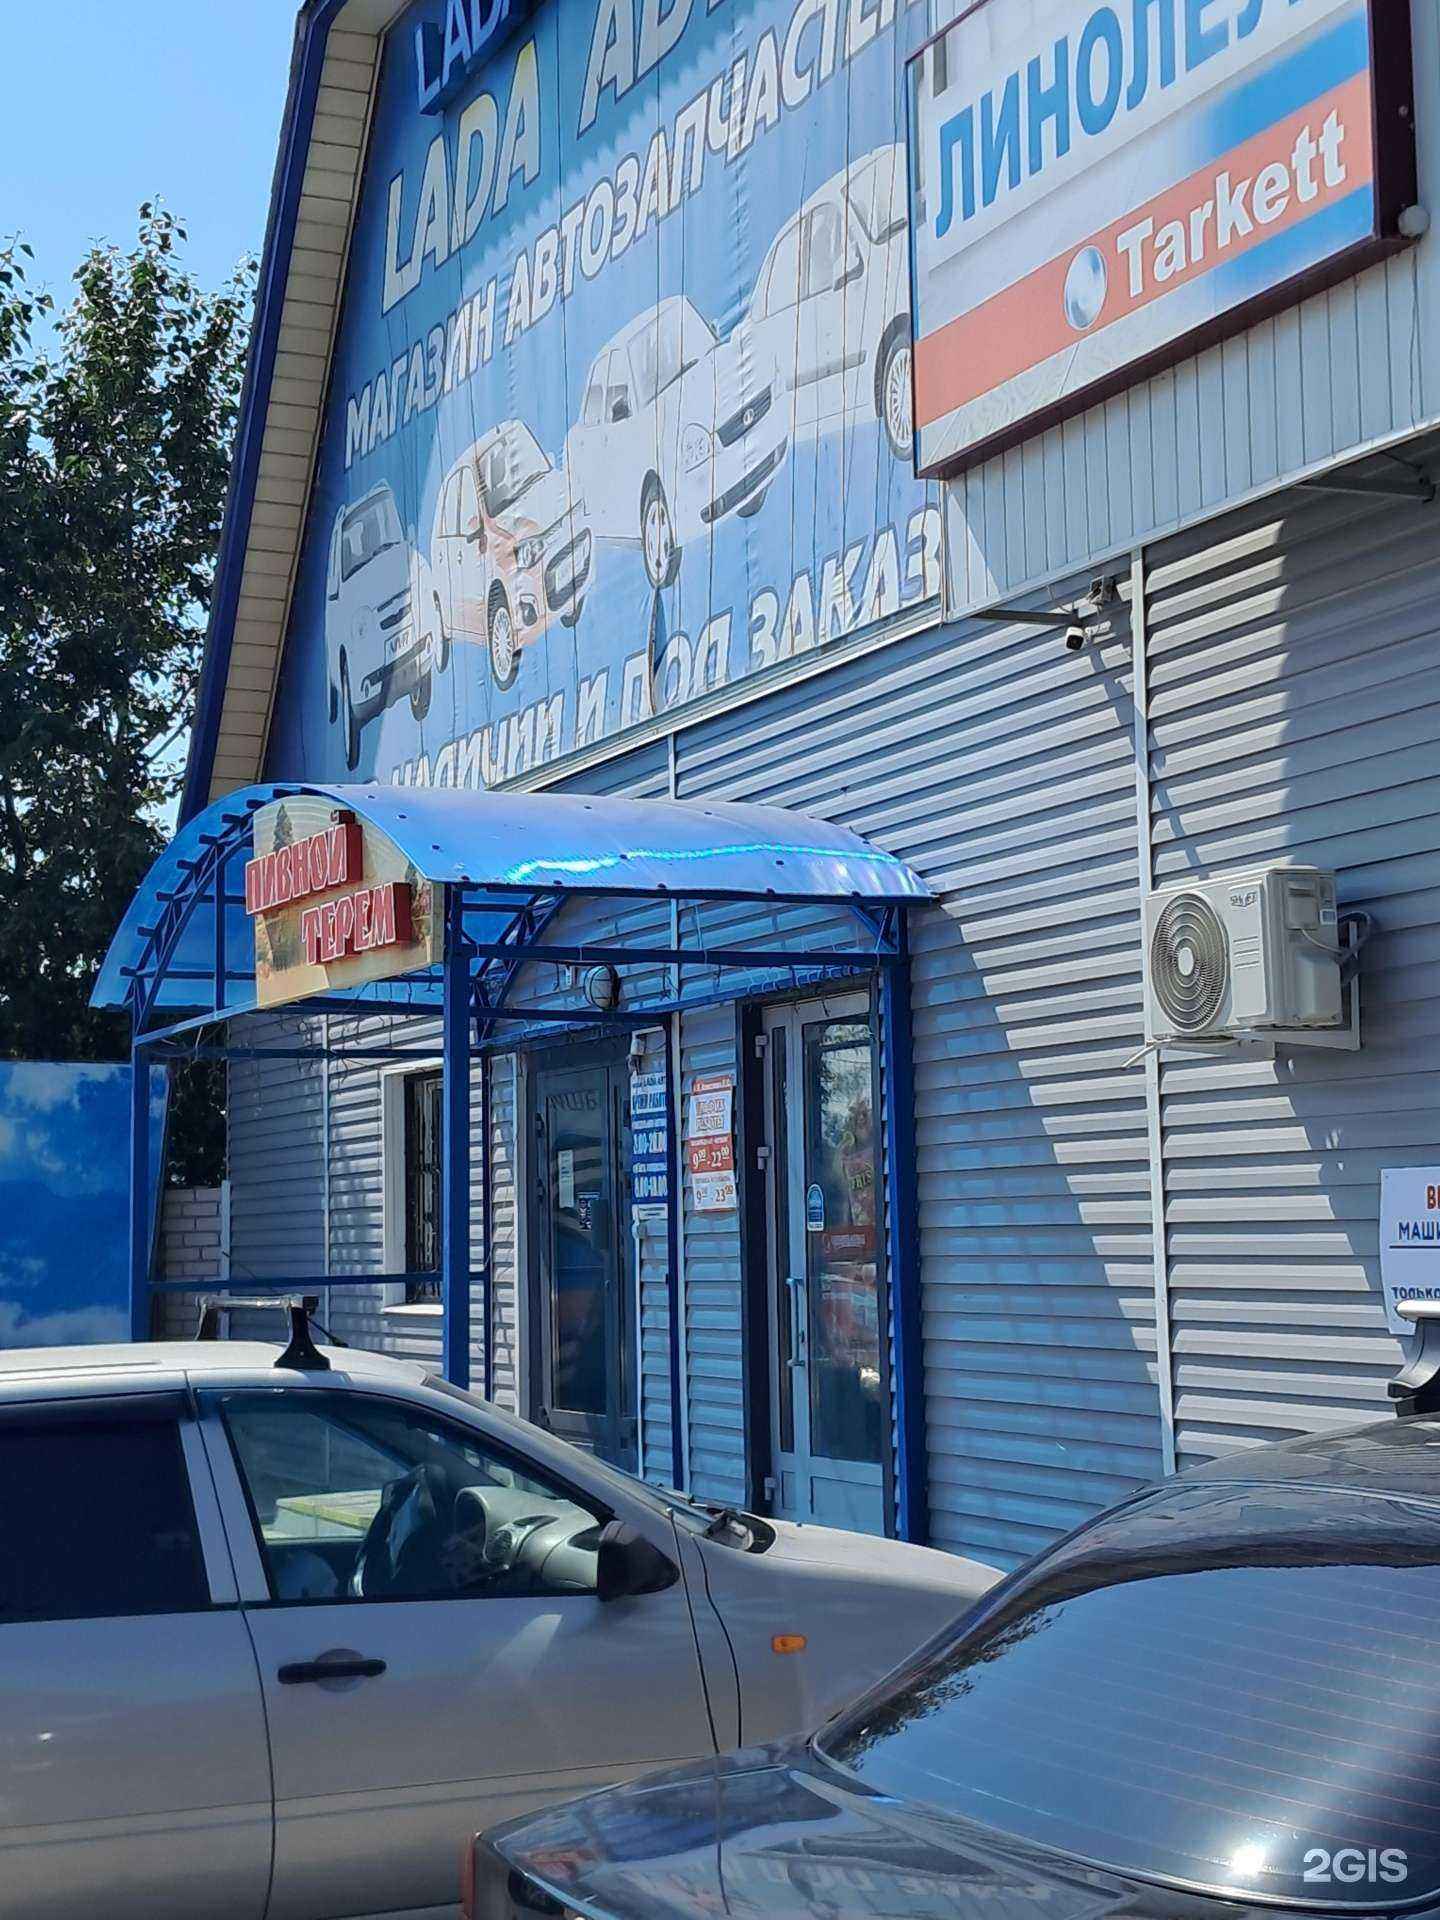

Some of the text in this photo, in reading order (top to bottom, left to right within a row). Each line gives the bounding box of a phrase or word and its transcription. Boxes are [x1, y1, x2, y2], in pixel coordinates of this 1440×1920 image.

[414, 0, 511, 109] LAD
[383, 35, 540, 317] LADA
[1117, 107, 1347, 298] Tarkett
[344, 283, 497, 470] МАГАЗИН
[750, 504, 942, 674] ЗАКАЗ
[246, 824, 347, 915] ПИВНОЙ
[302, 884, 395, 965] ТЕРЕМ
